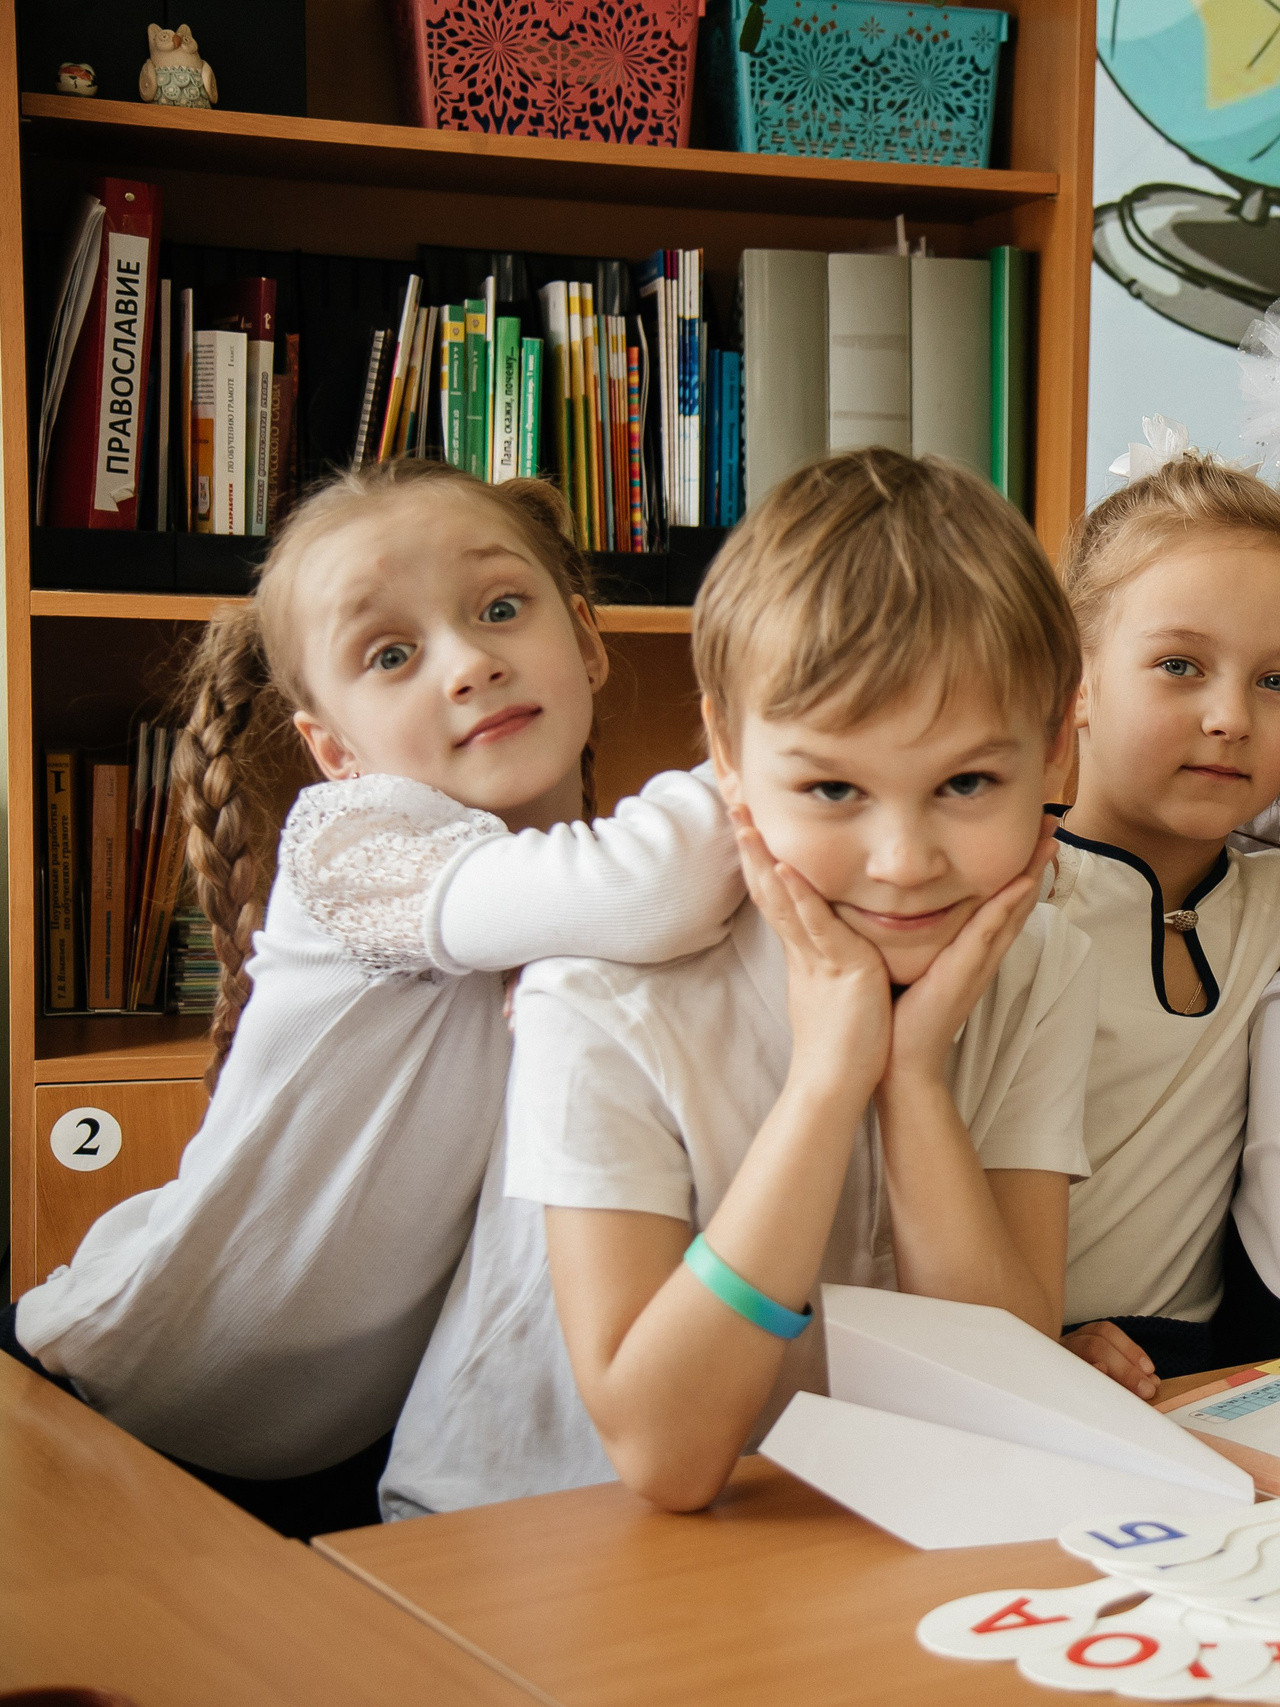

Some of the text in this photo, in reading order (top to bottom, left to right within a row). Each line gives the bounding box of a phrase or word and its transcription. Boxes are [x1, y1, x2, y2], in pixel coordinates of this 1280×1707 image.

[106, 258, 141, 474] ПРАВОСЛАВИЕ
[227, 377, 235, 413] ГРАМОТЕ
[227, 414, 236, 460] ОБУЧЕНИЮ
[60, 815, 70, 860] грамоте
[49, 803, 60, 930] Поурочные разработки
[61, 861, 71, 916] обучению
[72, 1117, 101, 1156] 2
[1088, 1520, 1189, 1549] Б
[970, 1597, 1070, 1634] А
[1067, 1633, 1159, 1668] О
